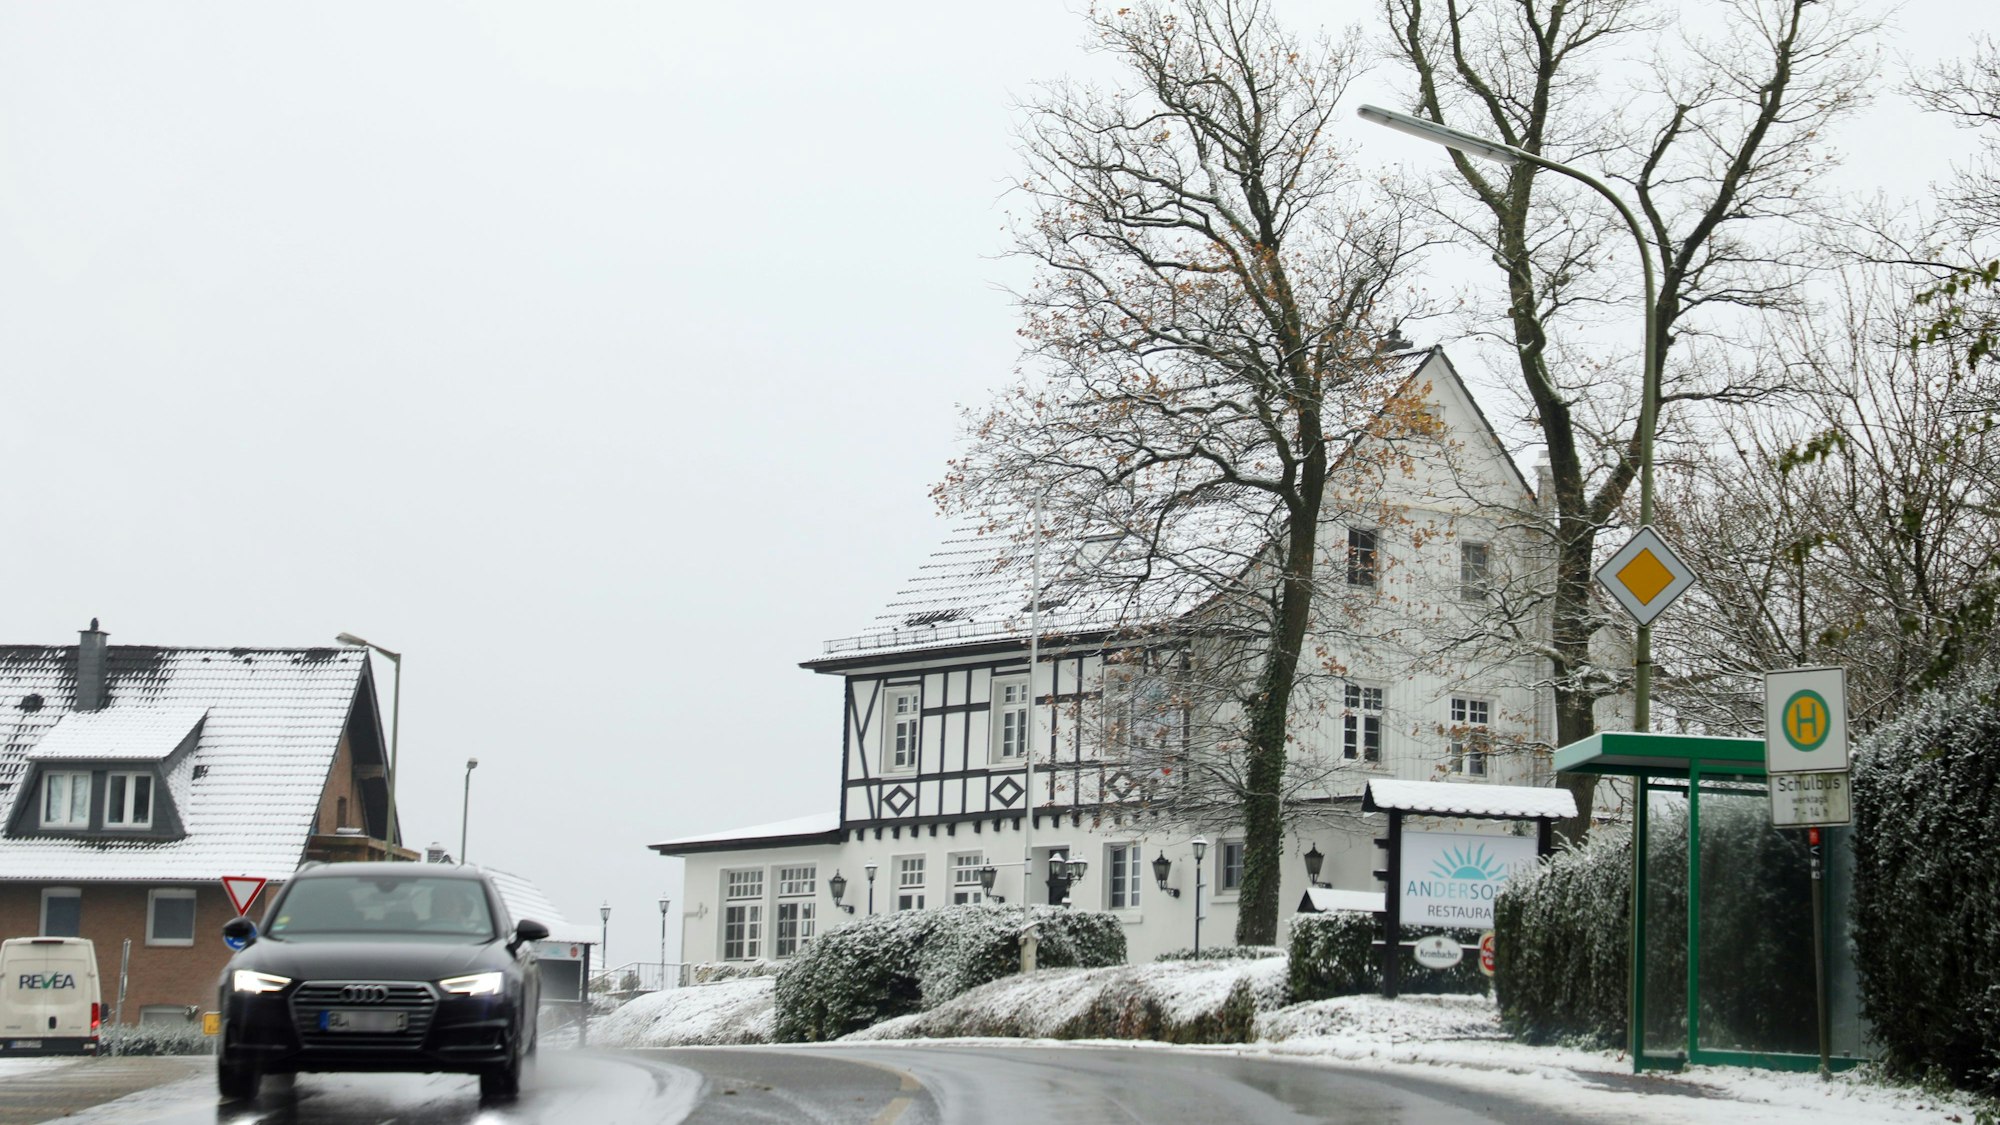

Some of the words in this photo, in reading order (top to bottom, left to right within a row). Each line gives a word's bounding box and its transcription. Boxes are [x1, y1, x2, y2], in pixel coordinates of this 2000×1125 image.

[1796, 703, 1817, 738] H
[1778, 777, 1841, 792] Schulbus
[1407, 880, 1499, 901] ANDERSO
[1428, 904, 1493, 919] RESTAURA
[1420, 949, 1458, 960] Krombacher
[19, 972, 75, 990] REVEA
